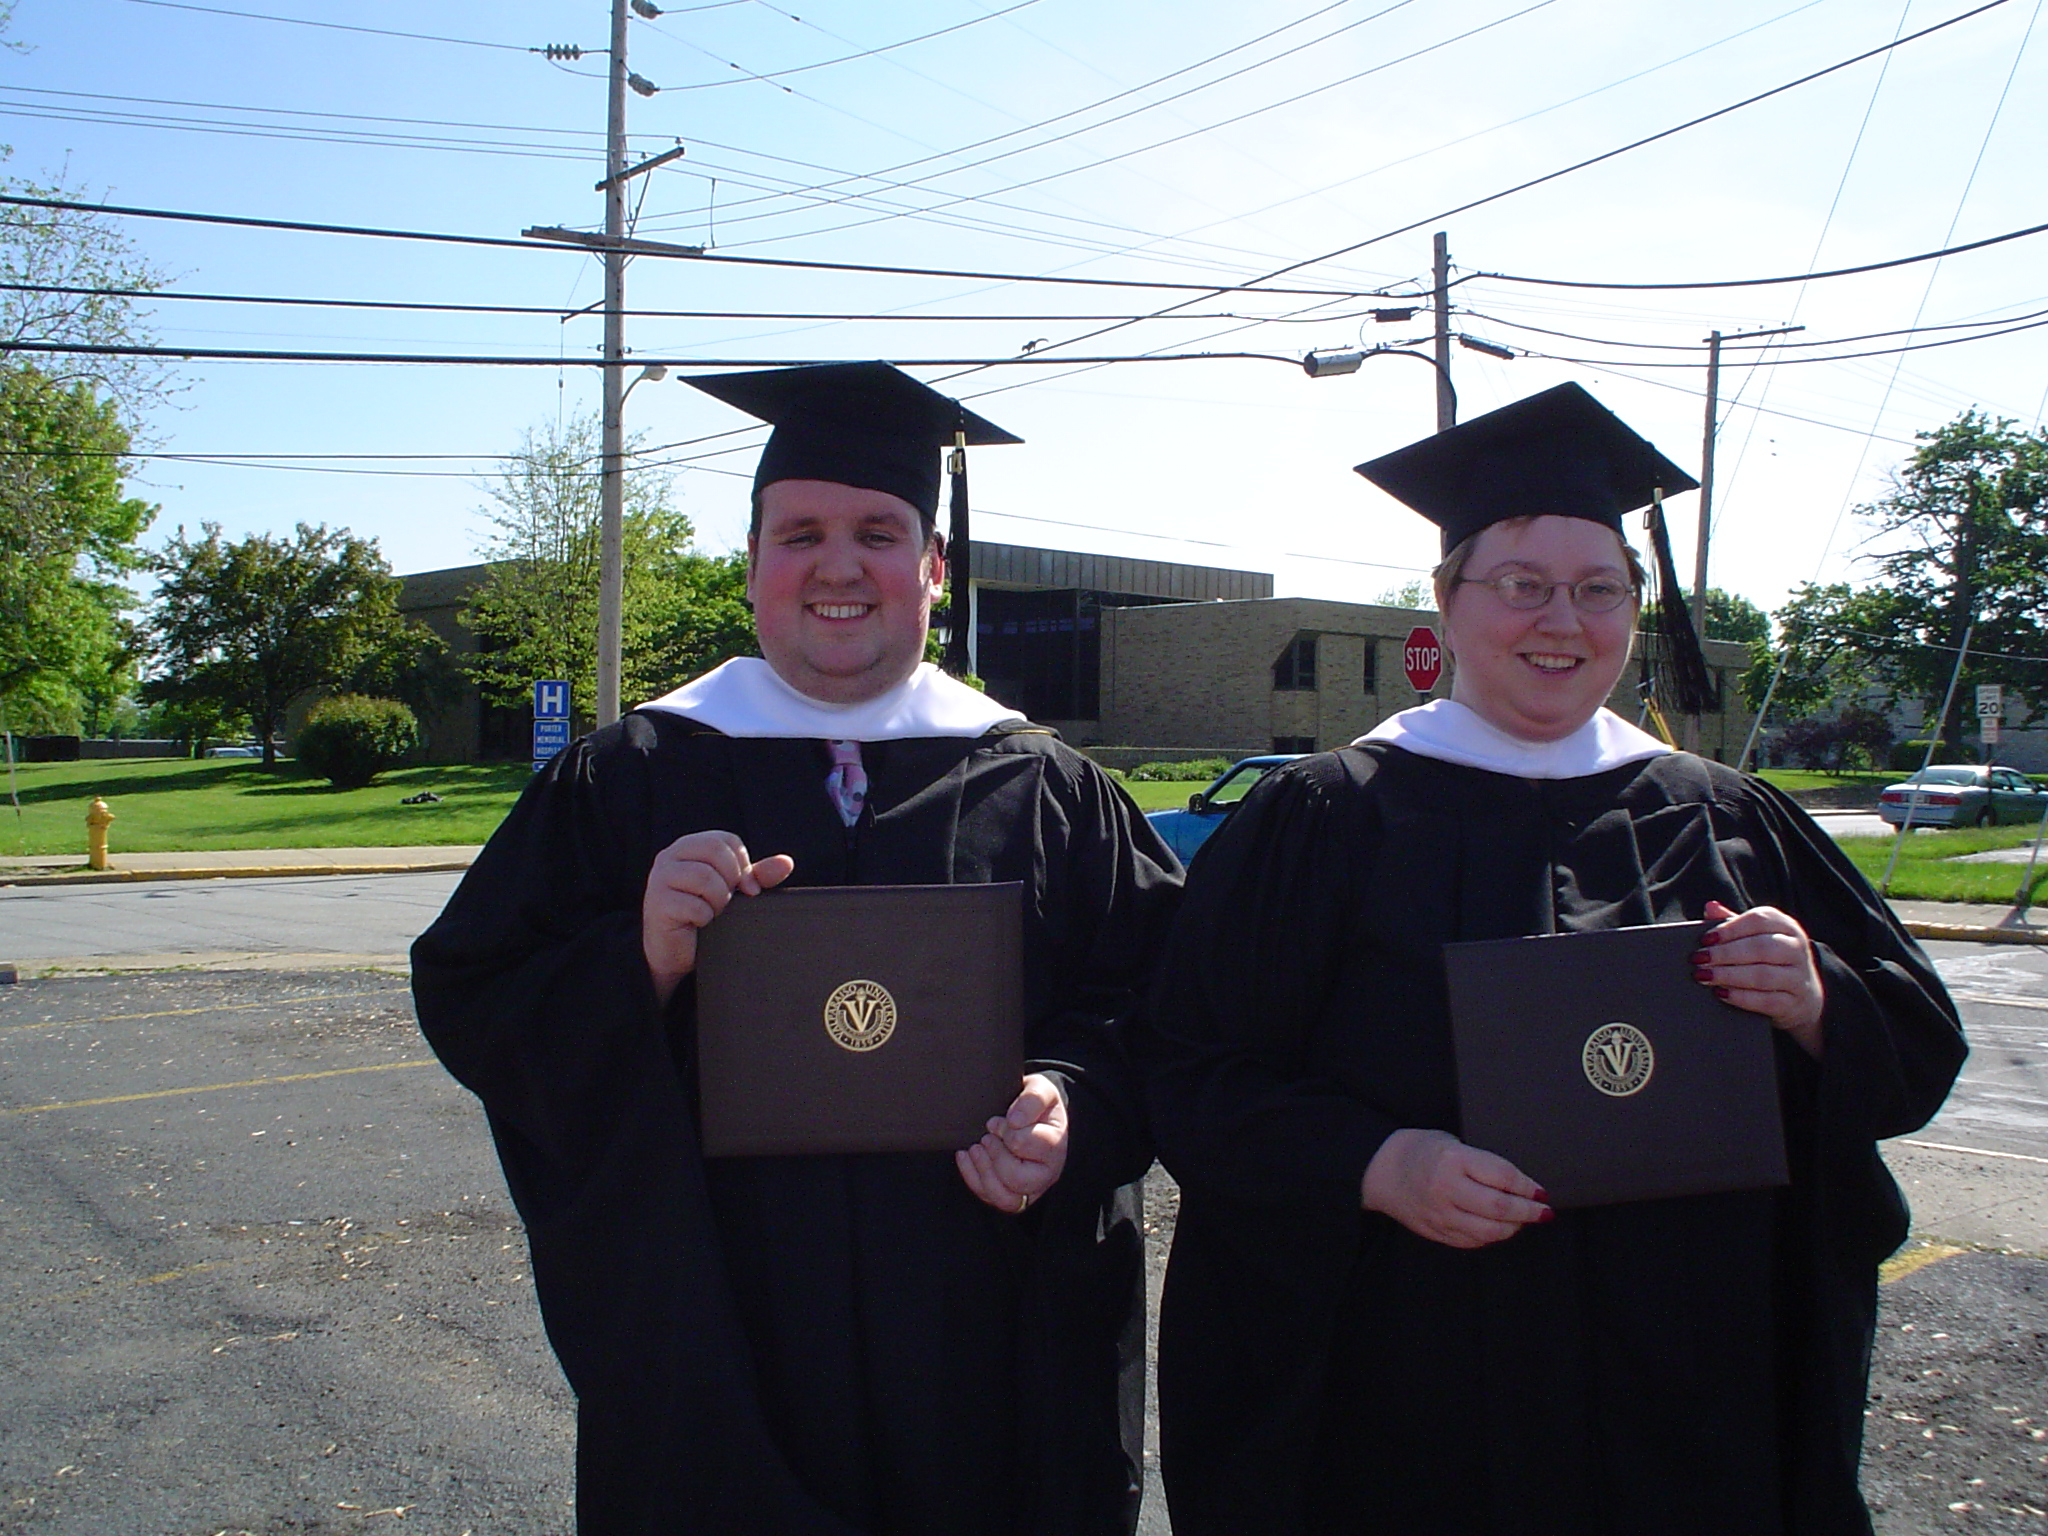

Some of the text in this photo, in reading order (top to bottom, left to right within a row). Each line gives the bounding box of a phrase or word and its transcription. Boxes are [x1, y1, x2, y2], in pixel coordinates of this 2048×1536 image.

[1406, 647, 1439, 671] STOP
[542, 685, 562, 713] H
[1979, 702, 1998, 714] 20
[540, 724, 562, 732] PORTER
[828, 984, 857, 1039] VALPARAISO
[866, 984, 894, 1038] UNIVERSITY
